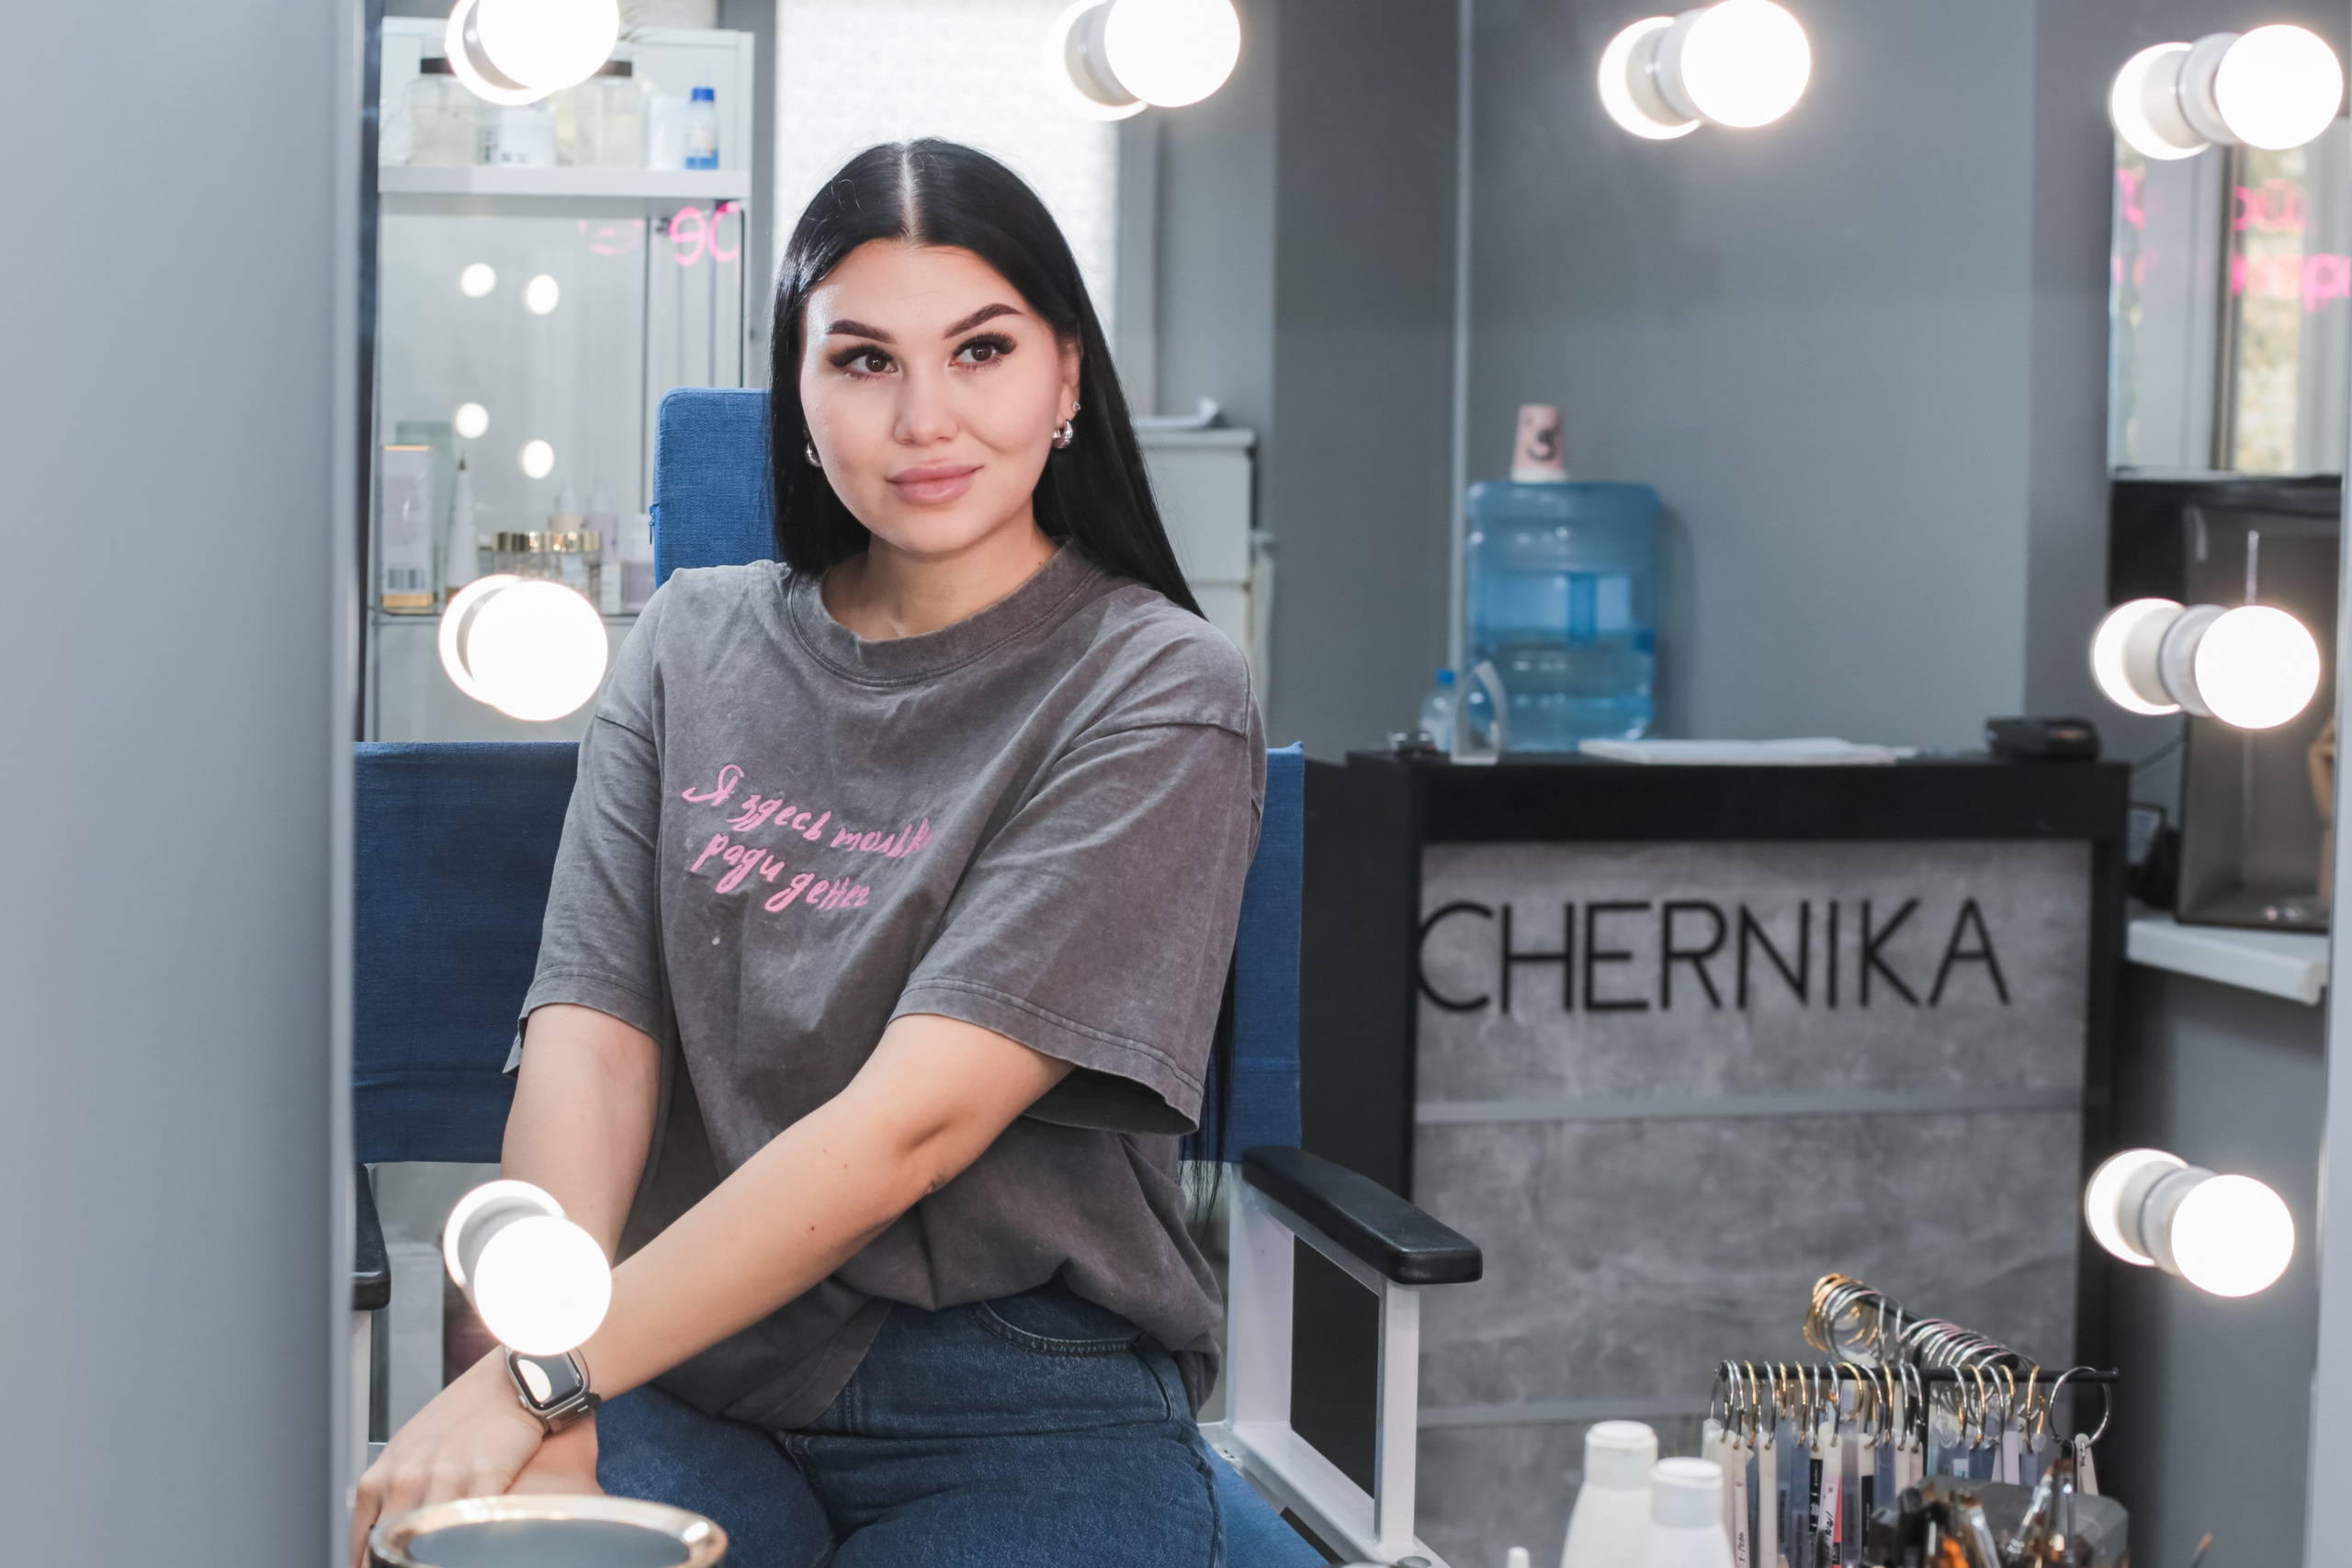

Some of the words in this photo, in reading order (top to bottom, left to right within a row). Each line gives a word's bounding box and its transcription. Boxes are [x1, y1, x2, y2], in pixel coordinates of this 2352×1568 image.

[682, 763, 744, 807] Я
[690, 833, 785, 894] ради
[1418, 897, 2011, 1014] CHERNIKA
